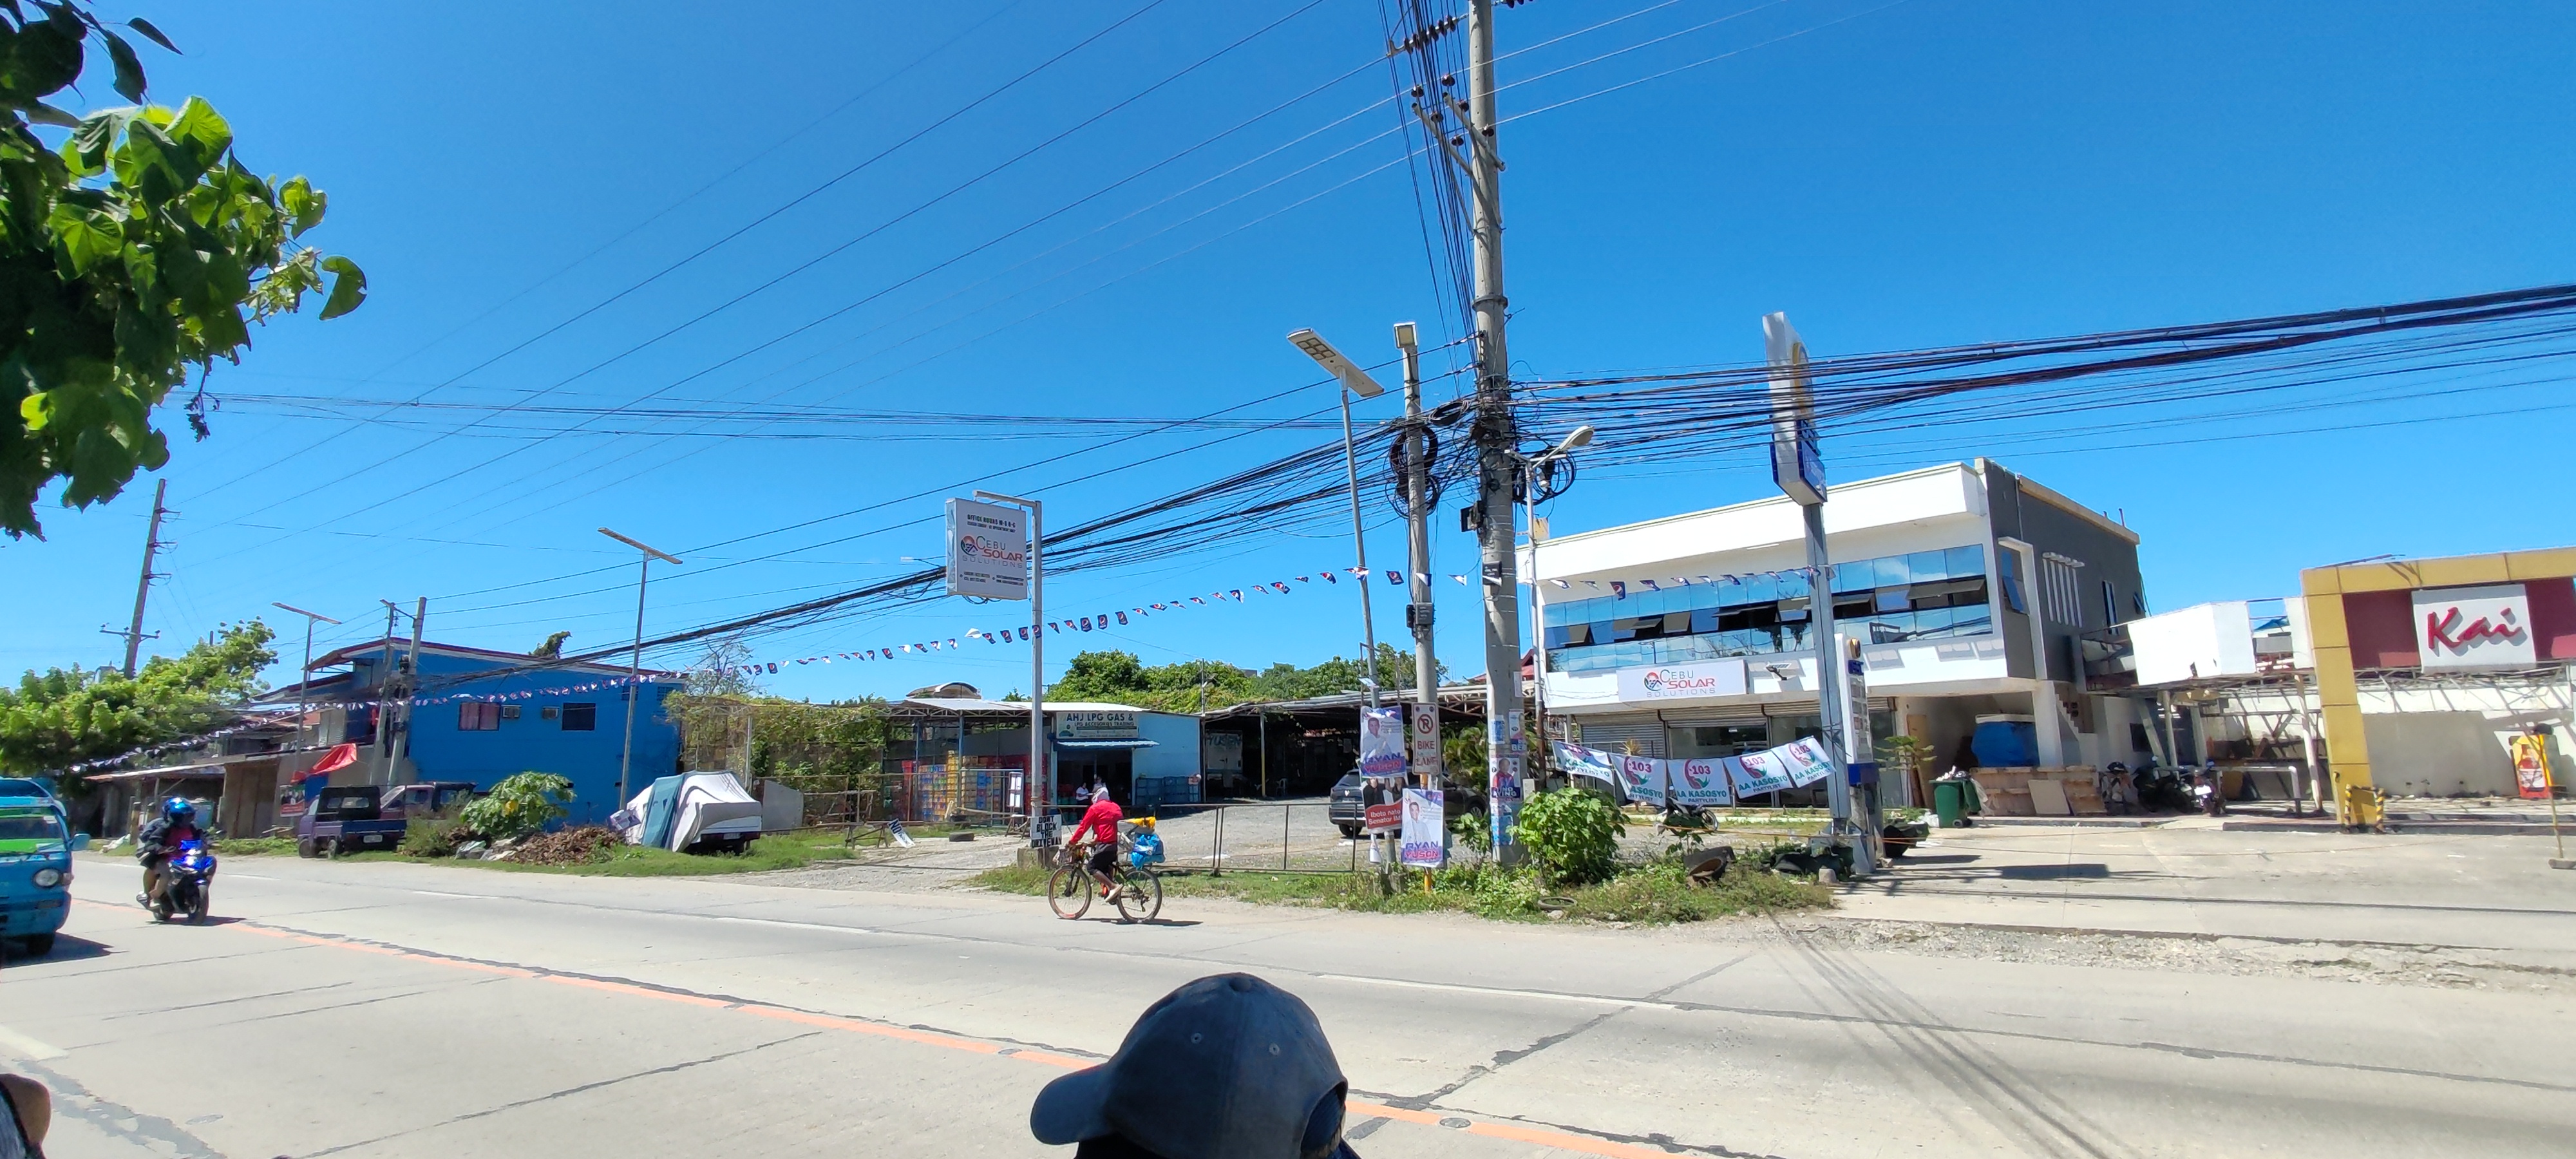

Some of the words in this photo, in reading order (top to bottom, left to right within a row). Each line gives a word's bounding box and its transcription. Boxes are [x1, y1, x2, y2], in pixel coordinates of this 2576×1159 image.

[976, 536, 1005, 550] CEBU
[981, 549, 1023, 562] SOLAR
[962, 555, 1023, 569] SOLUTIONS
[2427, 607, 2523, 649] Kai
[1660, 669, 1694, 683] CEBU
[1667, 678, 1716, 690] SOLAR
[1647, 688, 1716, 697] SOLUTIONS
[1066, 713, 1084, 721] AHJ
[1087, 713, 1104, 721] LPG
[1107, 713, 1125, 721] GAS
[1128, 713, 1133, 721] &
[1417, 740, 1435, 749] BIKE
[1795, 744, 1811, 755] 103
[1632, 760, 1652, 773] 103
[1747, 757, 1765, 766] 103
[1692, 765, 1710, 775] 103
[1794, 771, 1804, 781] AA
[1739, 782, 1751, 791] AA
[1752, 775, 1788, 787] KASOSYO
[1753, 783, 1781, 792] PARTYLIST
[1630, 786, 1663, 798] ASOSYO
[889, 818, 902, 834] NO
[1037, 822, 1057, 833] BLOCK
[1406, 841, 1438, 850] RYAN
